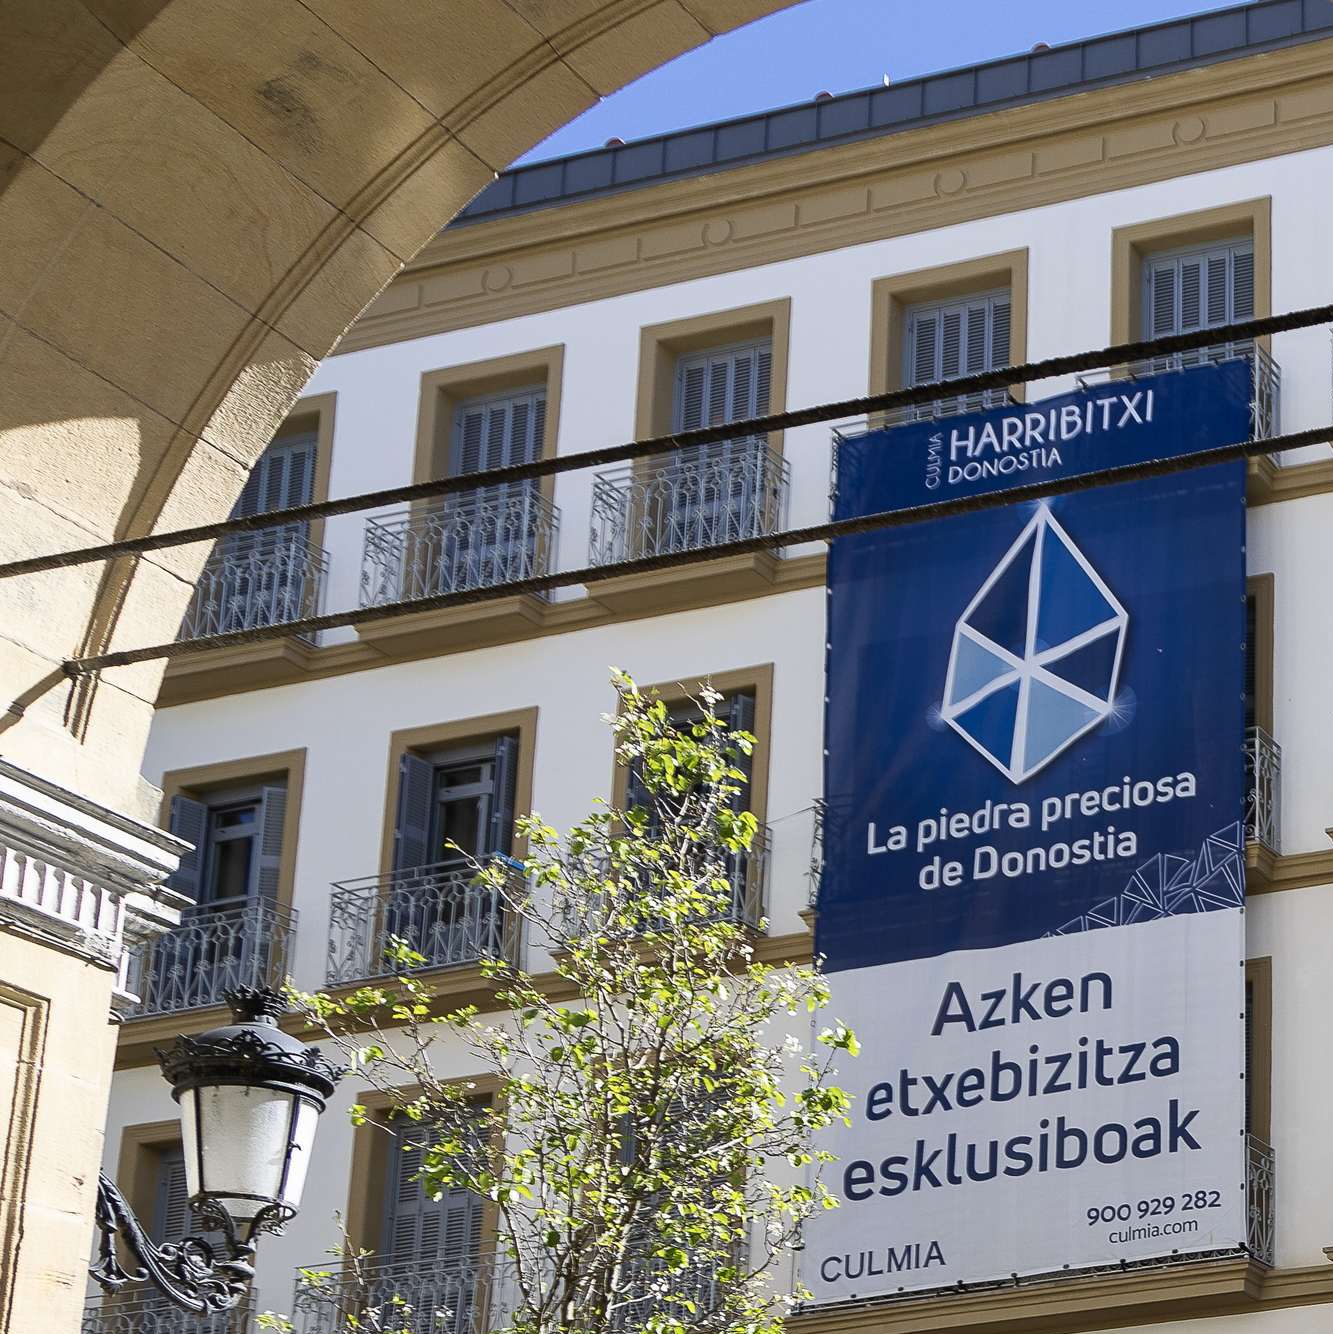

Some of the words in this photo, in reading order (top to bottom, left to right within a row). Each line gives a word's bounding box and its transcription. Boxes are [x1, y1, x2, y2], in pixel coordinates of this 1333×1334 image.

[950, 389, 1154, 461] HARRIBITXI
[925, 432, 943, 490] CULMIA
[948, 447, 1062, 484] DONOSTIA
[867, 822, 907, 855] La
[917, 800, 1030, 852] piedra
[1041, 771, 1197, 831] preciosa
[918, 856, 964, 891] de
[973, 826, 1137, 880] Donostia
[930, 971, 1113, 1036] Azken
[865, 1035, 1180, 1121] etxebizitza
[843, 1099, 1202, 1201] esklusiboak
[1087, 1204, 1131, 1226] 900
[1137, 1196, 1175, 1219] 929
[1181, 1190, 1222, 1211] 282
[1108, 1219, 1198, 1243] culmia.com
[820, 1240, 947, 1283] CULMIA
